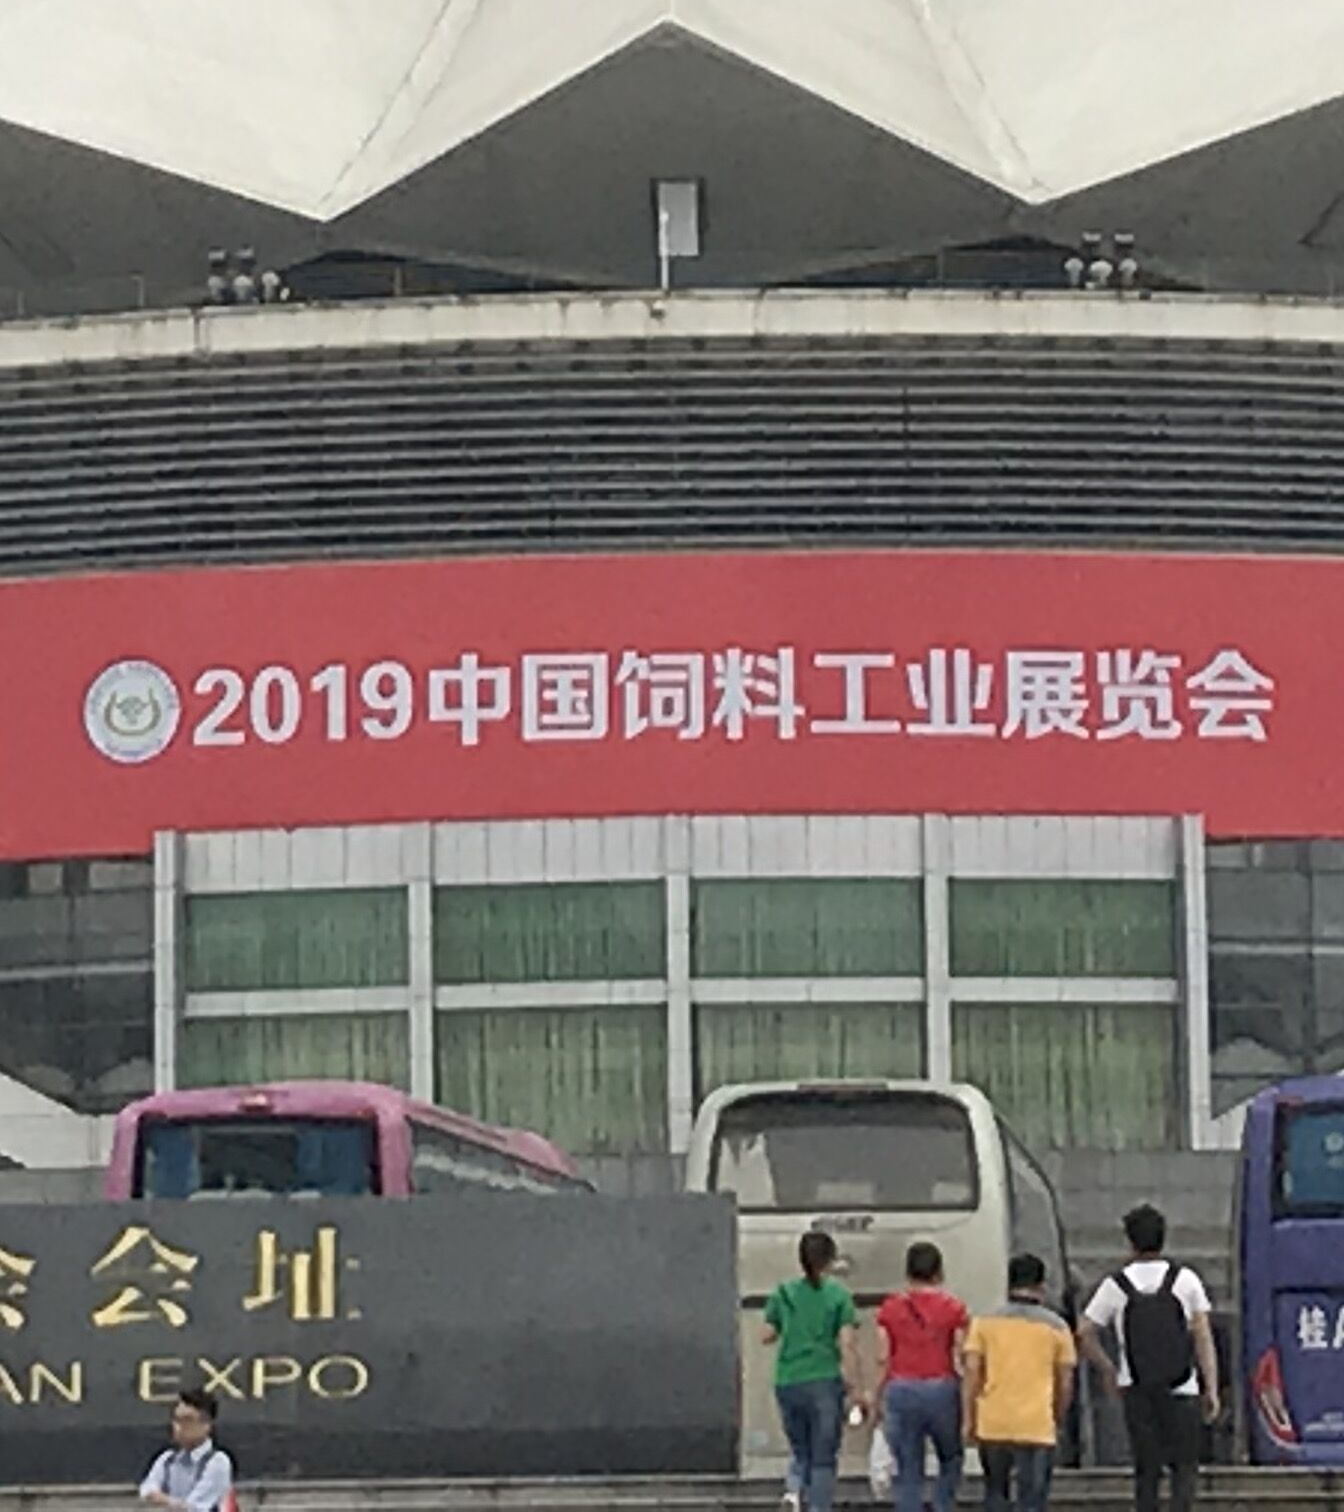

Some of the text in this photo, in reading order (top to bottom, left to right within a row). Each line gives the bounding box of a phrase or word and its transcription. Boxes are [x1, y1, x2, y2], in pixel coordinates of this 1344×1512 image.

[192, 647, 1275, 748] 2019中国饲料工业展览会
[139, 1355, 368, 1403] EXPO
